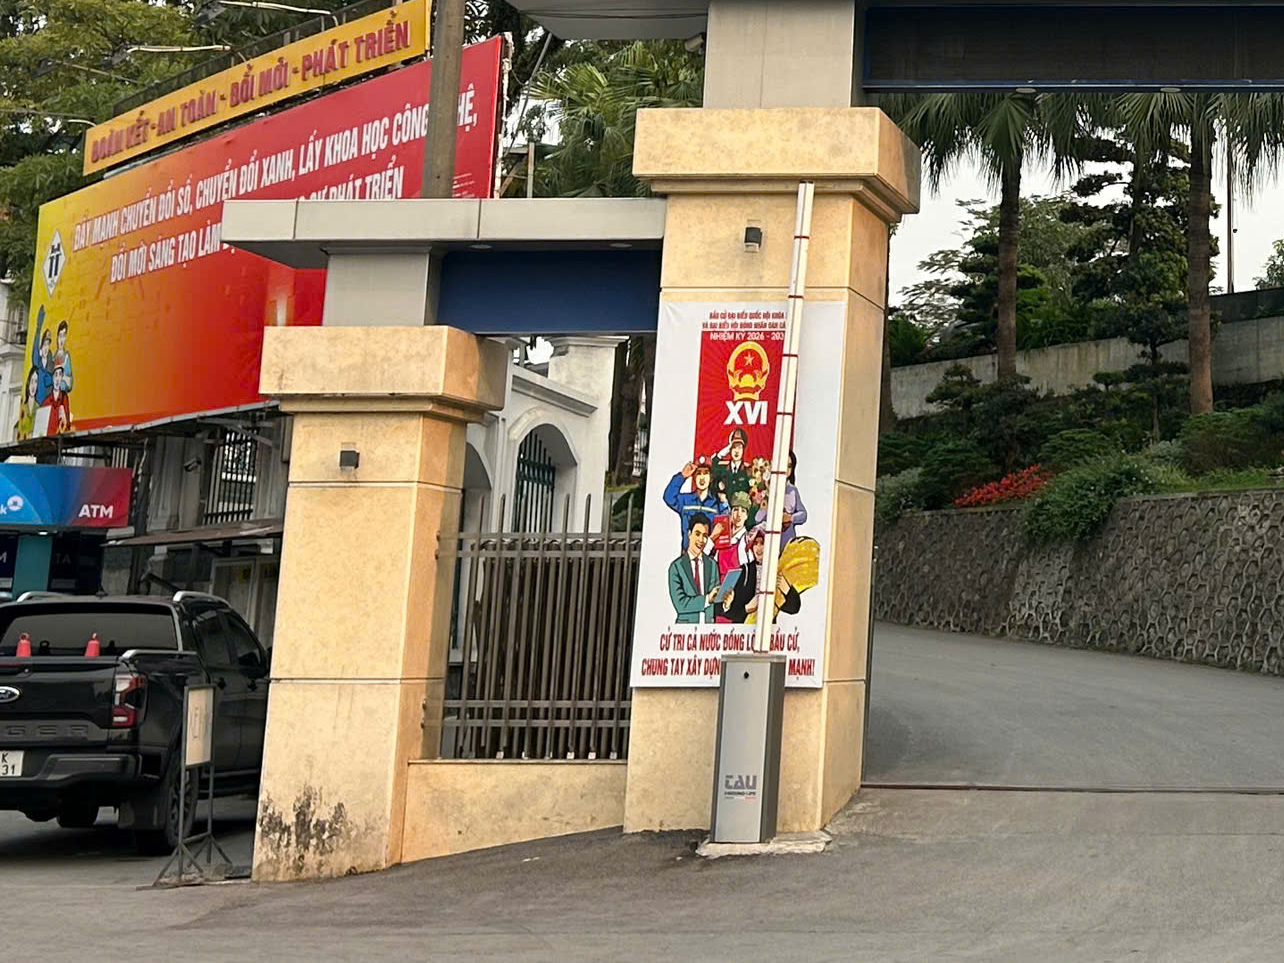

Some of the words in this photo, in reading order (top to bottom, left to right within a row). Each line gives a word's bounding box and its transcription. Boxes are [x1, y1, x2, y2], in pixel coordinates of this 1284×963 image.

[301, 38, 349, 81] PHÁT
[354, 10, 410, 63] TRIỂN
[195, 158, 238, 210] CHUYỂN
[239, 149, 260, 196] ĐỔI
[260, 148, 296, 188] XANH,
[298, 129, 323, 175] LẤY
[324, 126, 358, 168] KHOA
[361, 117, 390, 160] HỌC
[392, 103, 429, 146] CÔNG
[457, 82, 478, 132] HỆ,
[177, 229, 197, 268] TẠO
[365, 154, 405, 200] TRIỂN
[771, 332, 784, 340] 203
[723, 400, 768, 425] XVI
[78, 504, 114, 519] ATM
[659, 627, 673, 651] CỬ
[673, 633, 685, 651] TRI
[686, 626, 698, 651] CẢ
[699, 628, 722, 652] NƯỚC
[722, 628, 745, 651] ĐỒNG
[641, 658, 668, 676] CHUNG
[670, 658, 685, 676] TAY
[686, 654, 702, 676] XÂY
[704, 657, 722, 680] DỰN
[788, 658, 816, 681] MẠNH!
